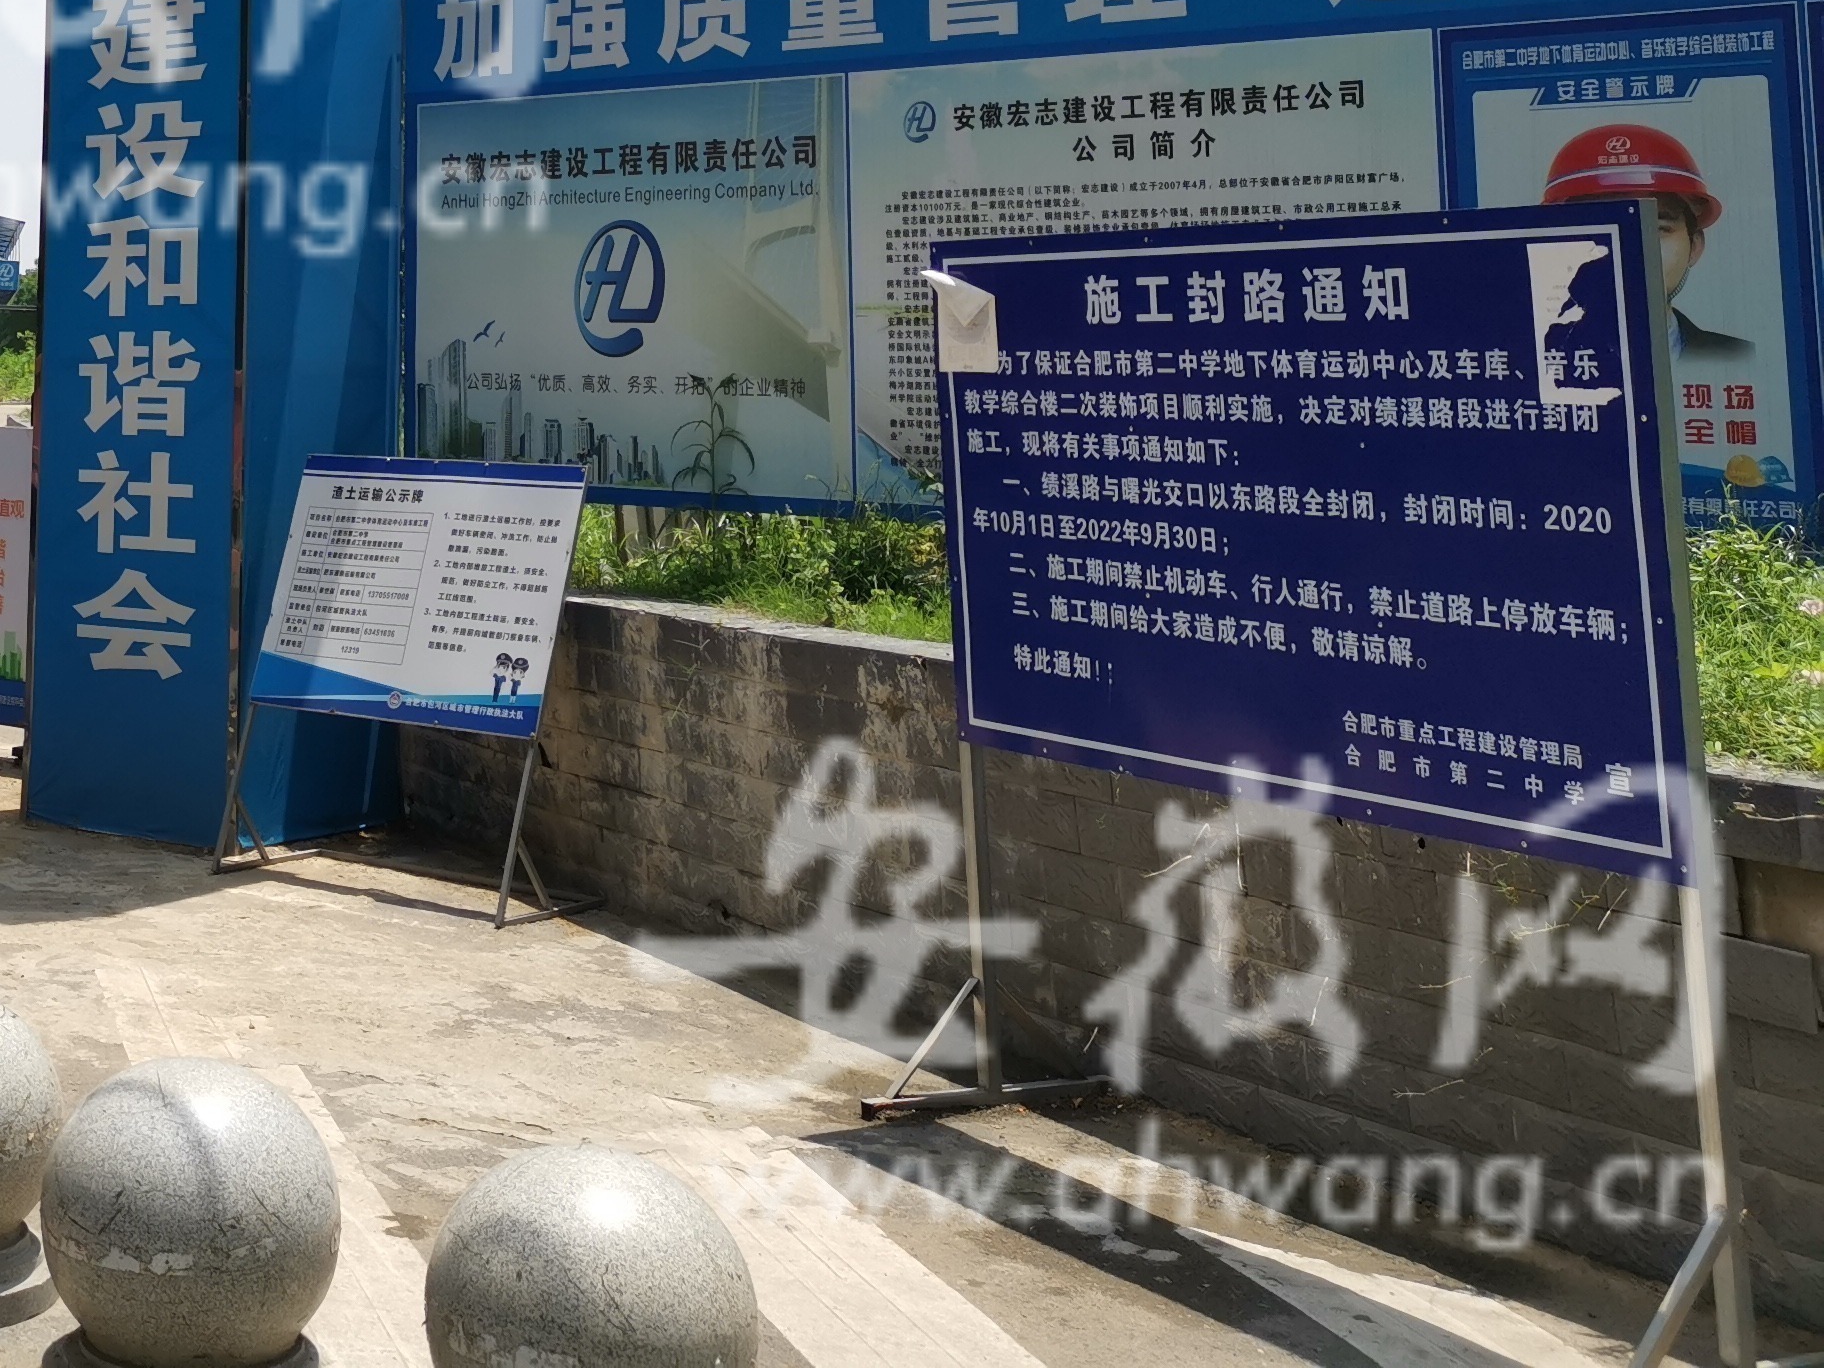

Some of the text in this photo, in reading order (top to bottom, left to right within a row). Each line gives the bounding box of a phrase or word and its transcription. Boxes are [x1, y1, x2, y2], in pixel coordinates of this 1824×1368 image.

[953, 79, 1365, 130] 安徽宏志建设工程有限责任公司
[1556, 75, 1674, 101] 安全警示牌
[441, 135, 817, 184] 安徽宏志建设工程有限责任公司
[1073, 128, 1215, 162] 公司简介
[442, 179, 818, 209] AnHui HongZhi Architecture Engineering Company Ltd.
[1084, 264, 1411, 326] 施工封路通知
[1683, 384, 1755, 409] 现场
[967, 428, 1241, 469] 施工，现将有关事项通知如下：
[1684, 419, 1756, 445] 全帽
[332, 486, 424, 504] 渣土运输公示牌
[1342, 710, 1584, 770] 合肥市重点工程建设管理局
[1344, 744, 1585, 807] 合肥市第二中学
[1606, 762, 1634, 798] 宣
